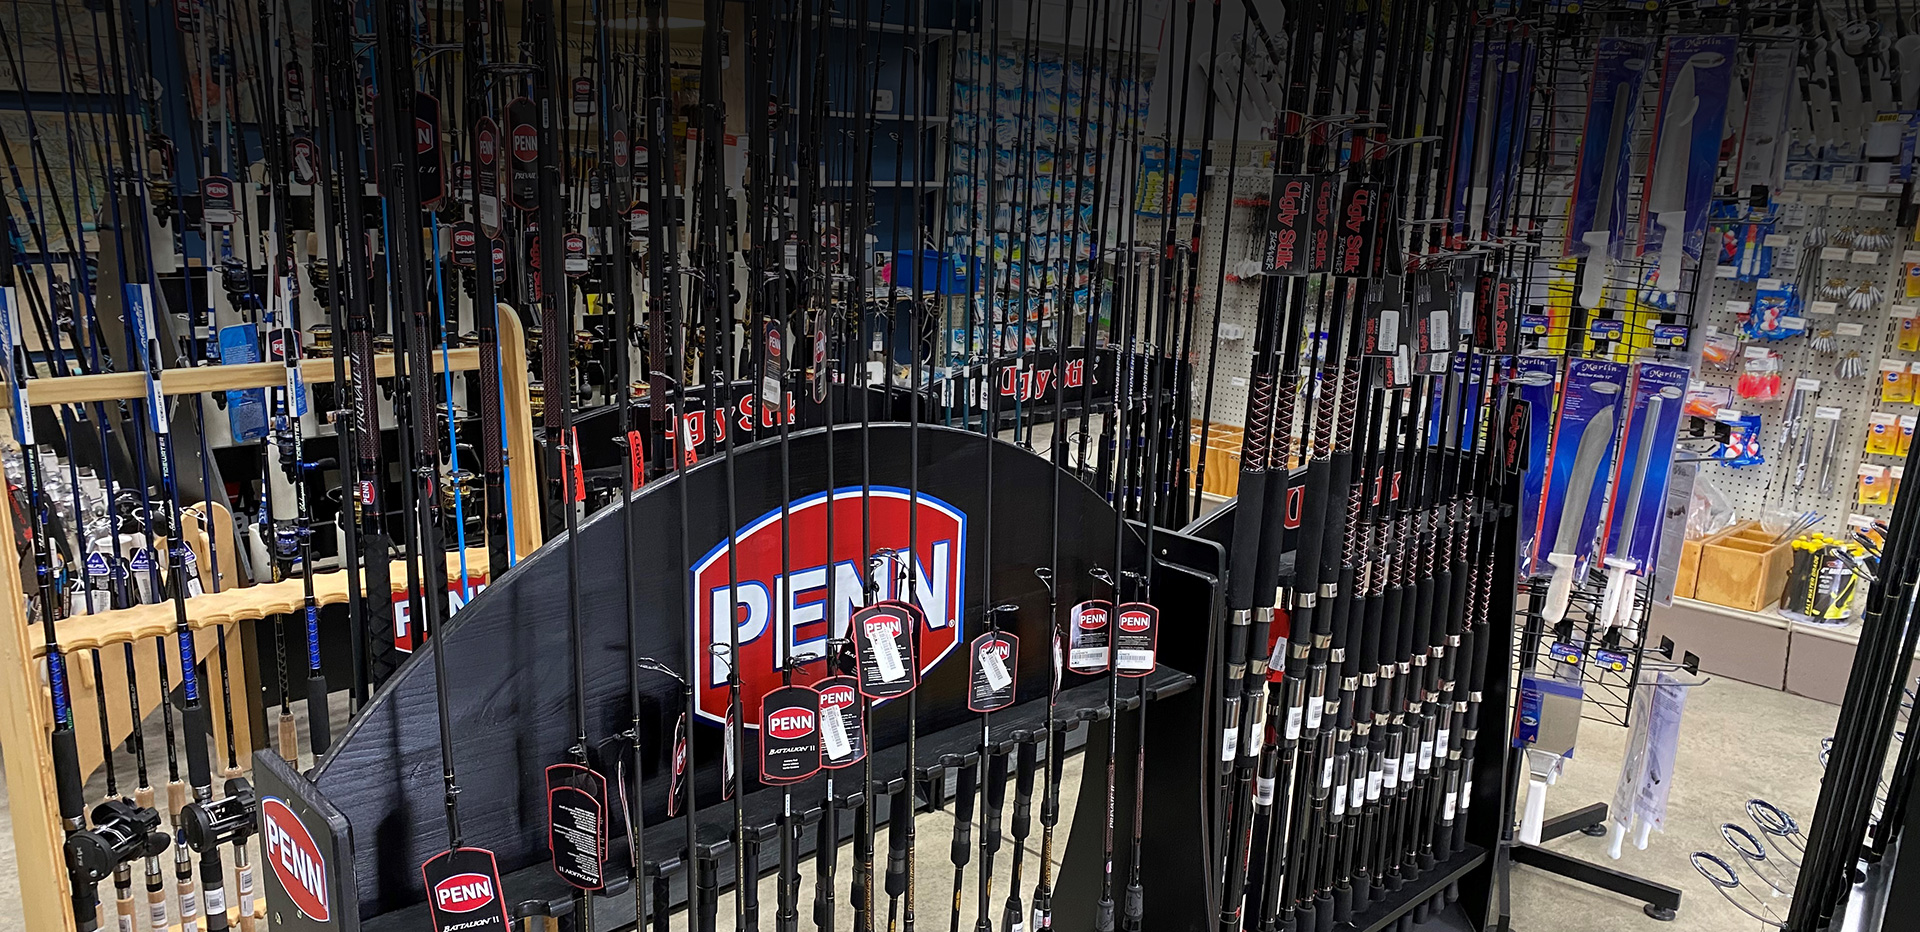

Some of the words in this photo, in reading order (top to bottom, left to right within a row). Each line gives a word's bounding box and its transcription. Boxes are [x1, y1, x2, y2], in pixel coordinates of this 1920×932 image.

[514, 135, 538, 151] PENN
[1277, 181, 1303, 228] Ugly
[1316, 181, 1331, 228] Ugly
[1346, 189, 1369, 233] Ugly
[1275, 229, 1297, 270] Stik
[1315, 229, 1328, 270] Stik
[1344, 234, 1363, 274] Stik
[1582, 363, 1617, 372] Marlin
[1649, 369, 1682, 379] Marlin
[351, 366, 367, 434] PREVAIL
[294, 422, 302, 461] TIDEWATER
[28, 449, 38, 491] TIDEWATER
[159, 437, 169, 478] TIDEWATER
[361, 481, 370, 504] PENN
[1807, 577, 1815, 598] WATER
[711, 540, 950, 688] PENN
[1080, 614, 1105, 624] PENN
[1120, 616, 1149, 627] PENN
[820, 691, 852, 705] PENN
[771, 715, 813, 732] PENN
[768, 746, 808, 756] BATTALION
[266, 814, 325, 906] PENN
[439, 881, 490, 905] PENN
[443, 917, 491, 932] BATTALION
